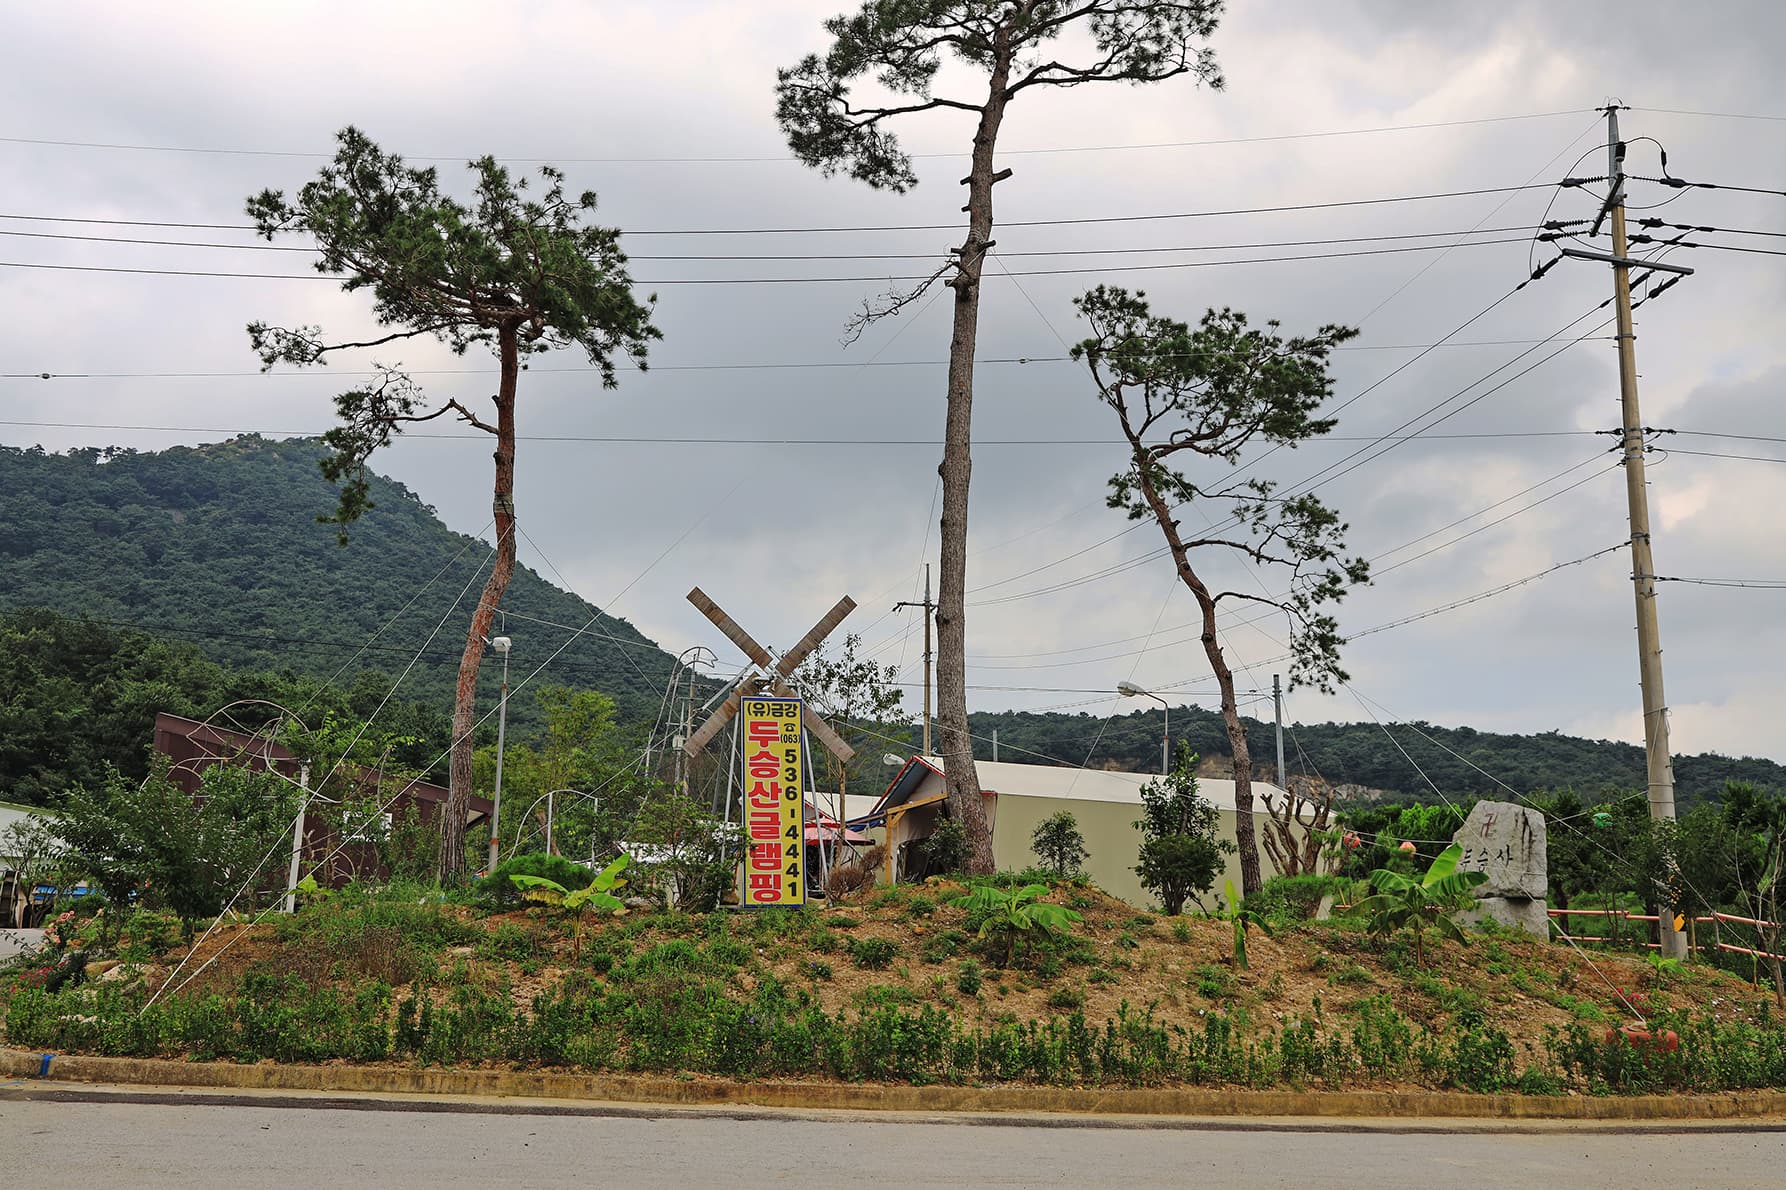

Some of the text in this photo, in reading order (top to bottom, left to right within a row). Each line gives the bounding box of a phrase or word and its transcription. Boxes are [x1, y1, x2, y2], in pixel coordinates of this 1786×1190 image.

[747, 702, 798, 718] (유)금강
[780, 734, 800, 743] (063)
[748, 721, 782, 902] 두승산글램핑
[784, 749, 800, 897] 536-4441
